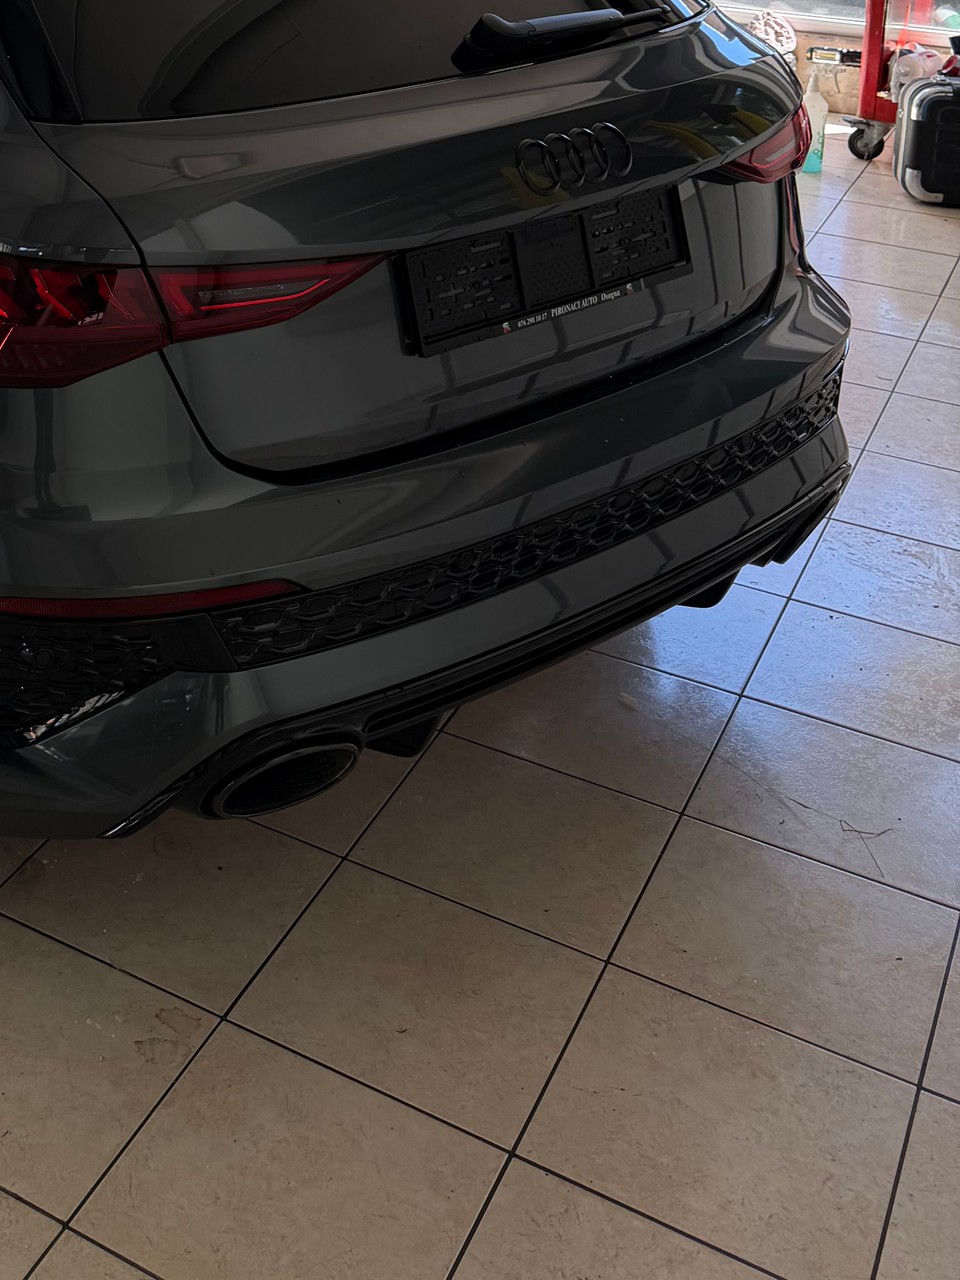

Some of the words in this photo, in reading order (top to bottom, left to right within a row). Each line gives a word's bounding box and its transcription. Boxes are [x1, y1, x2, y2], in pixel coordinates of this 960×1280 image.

[551, 301, 581, 317] PIRONACI
[581, 296, 598, 308] AUTO
[601, 290, 621, 301] Osogna
